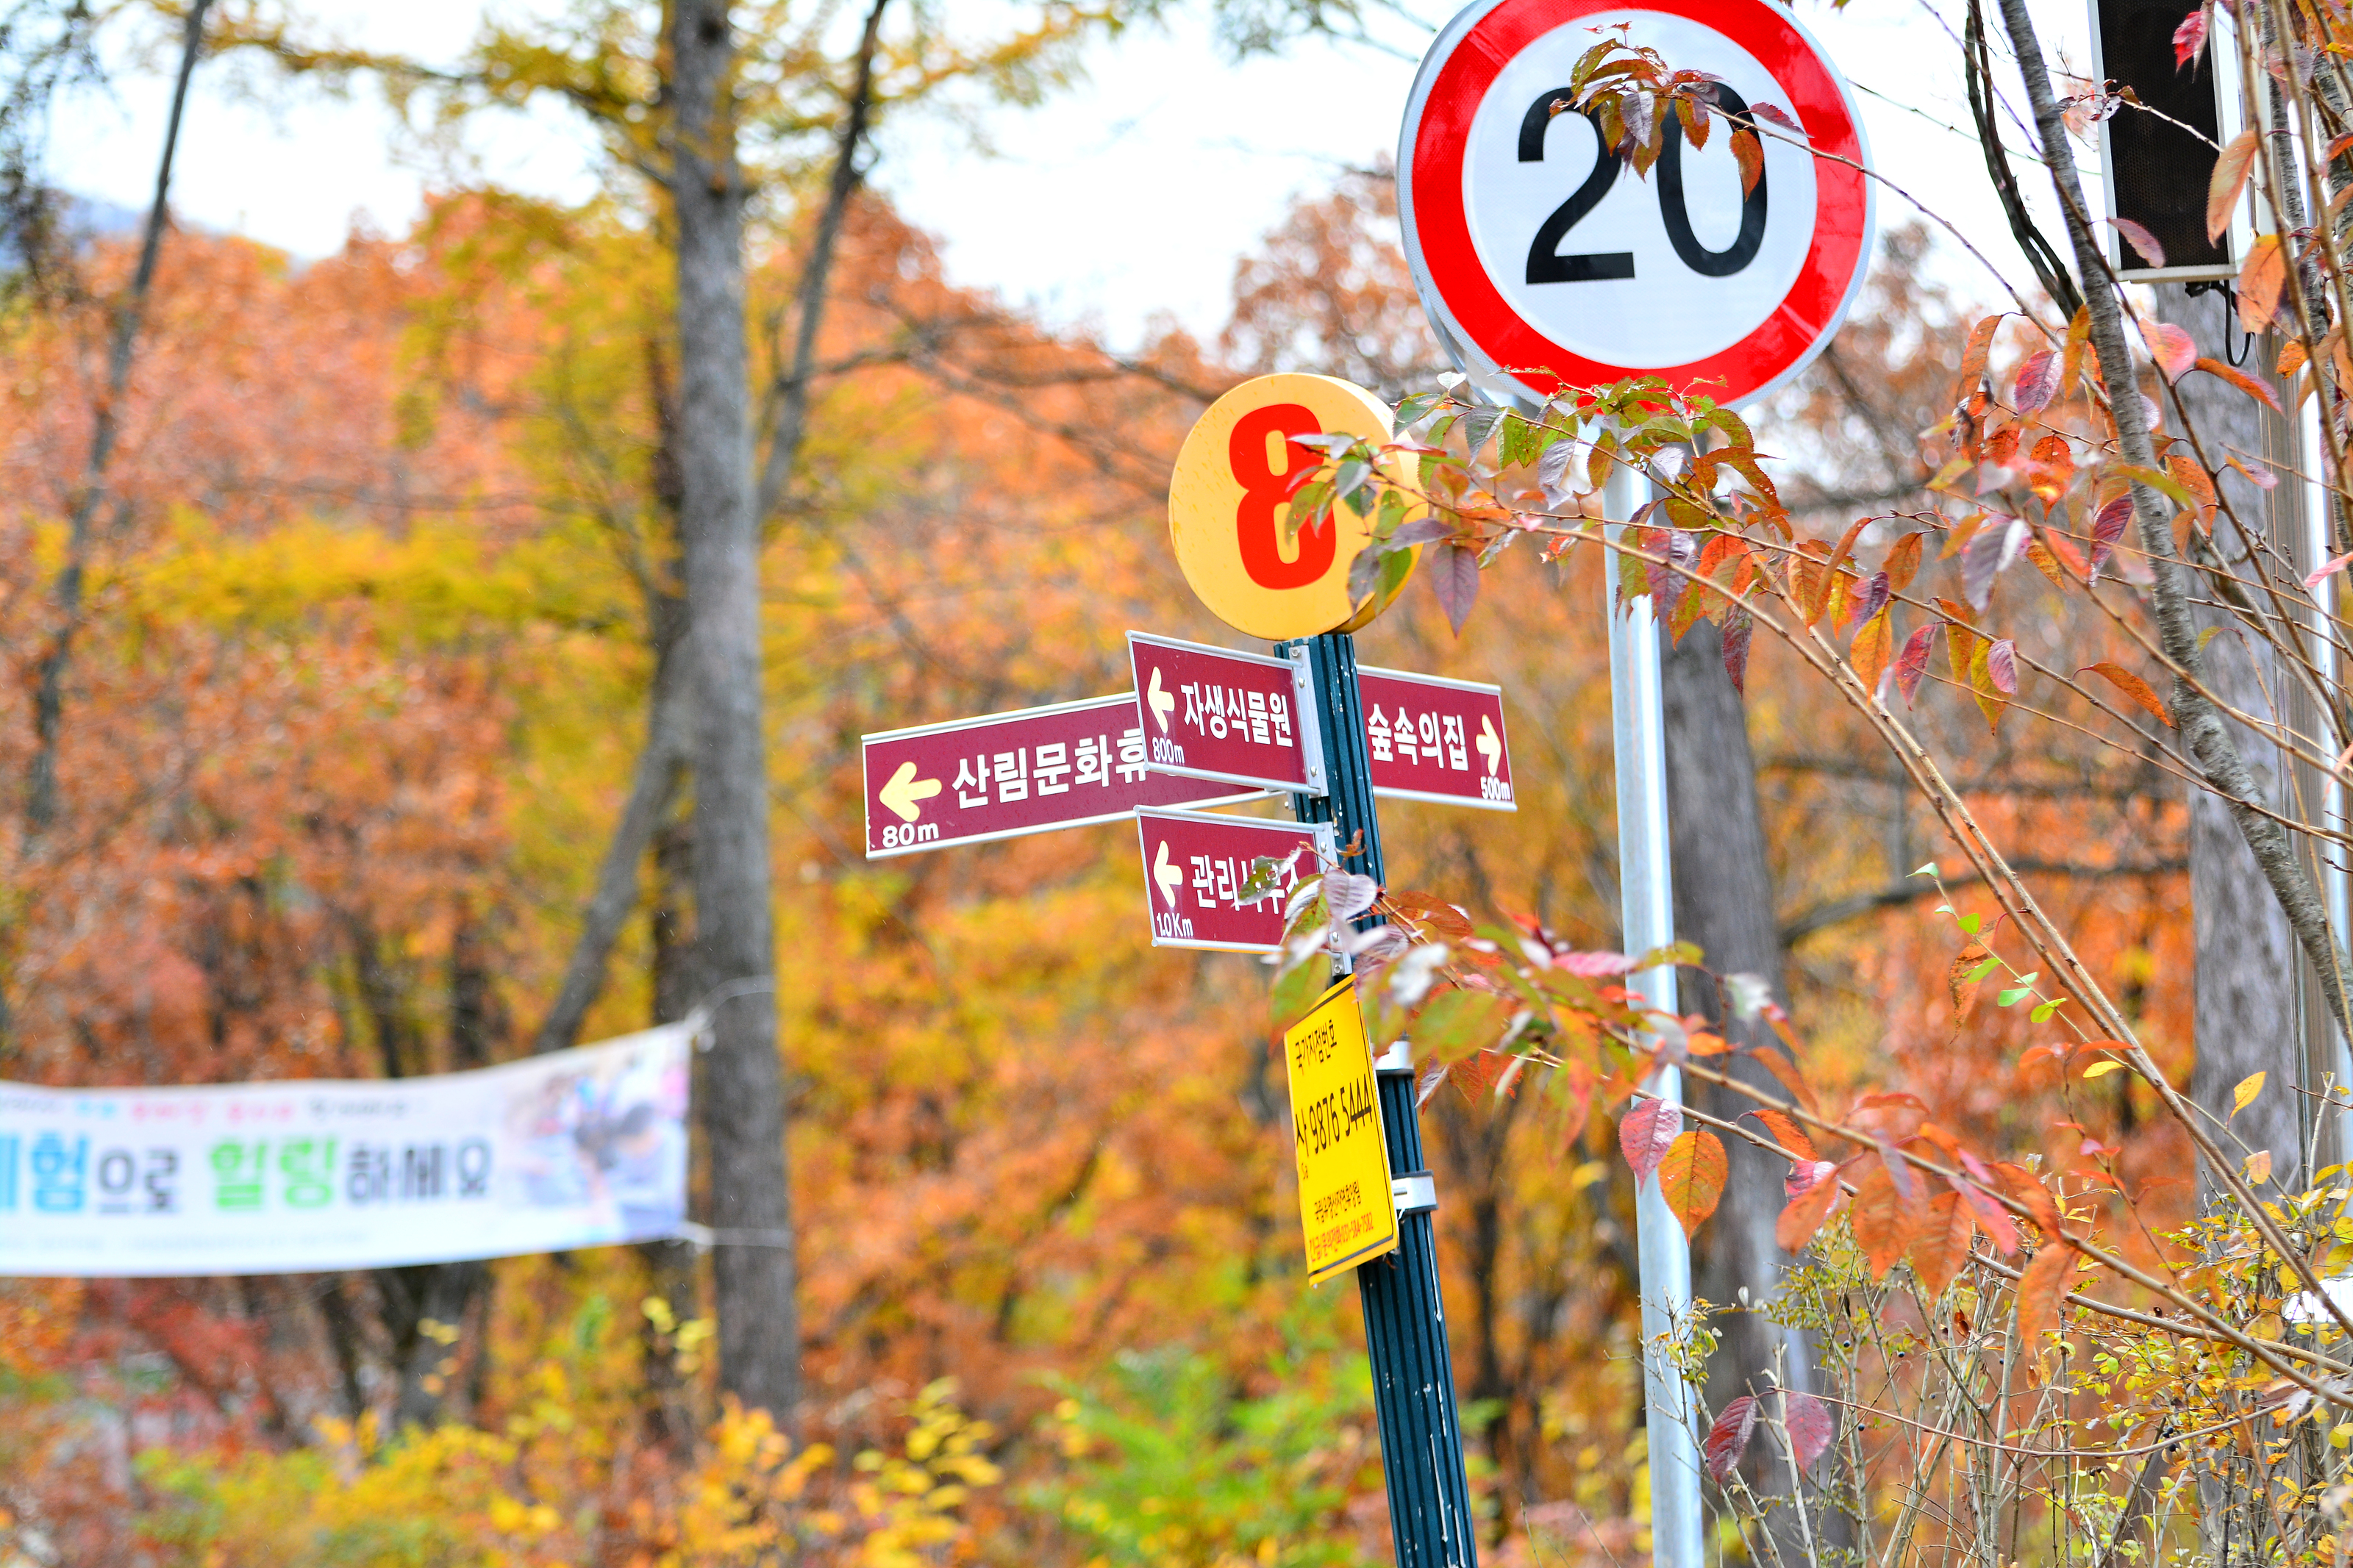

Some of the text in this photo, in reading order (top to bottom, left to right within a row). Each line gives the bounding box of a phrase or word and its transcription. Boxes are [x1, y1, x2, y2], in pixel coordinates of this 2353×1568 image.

[1517, 79, 1767, 284] 20
[1229, 403, 1338, 590] 8
[1180, 683, 1293, 748] 자생식물원
[1368, 704, 1468, 771] 숲속의집
[951, 728, 1147, 809] 산림문화휴
[1151, 737, 1185, 765] 800m
[1480, 776, 1511, 801] 500m
[882, 821, 940, 848] 80m
[1295, 1019, 1338, 1075] 국가지점번호
[1296, 1073, 1373, 1158] 사 9876 5444
[208, 1135, 492, 1214] 힐링하세요
[1301, 1162, 1309, 1180] Sa
